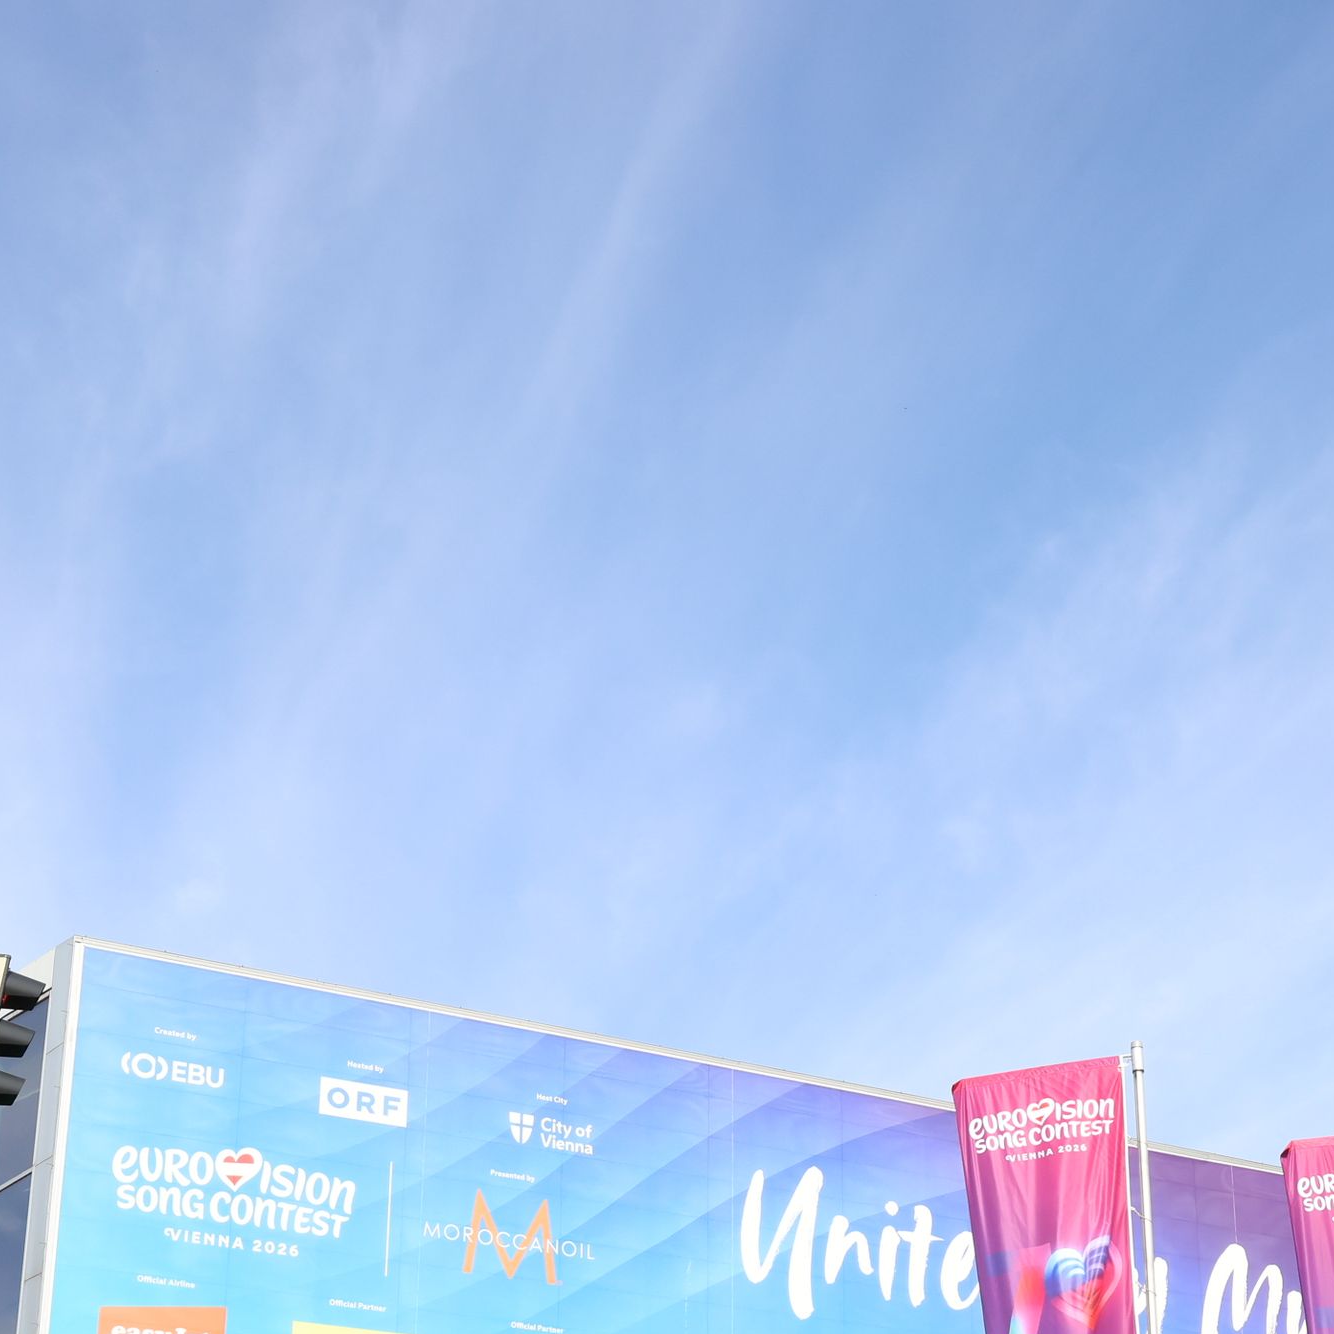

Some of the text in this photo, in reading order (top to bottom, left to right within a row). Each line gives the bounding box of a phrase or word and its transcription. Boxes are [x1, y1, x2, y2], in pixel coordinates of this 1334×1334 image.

[154, 1027, 197, 1041] Created by
[171, 1060, 225, 1088] EBU
[347, 1059, 384, 1074] Hosted by
[327, 1087, 401, 1117] ORF
[536, 1093, 568, 1105] Host City
[540, 1118, 593, 1139] City of
[974, 1120, 1113, 1154] SONG CONTEST
[540, 1133, 594, 1155] Vienna
[1005, 1143, 1087, 1163] VIENNA 2026
[490, 1169, 535, 1183] Presented by
[116, 1184, 349, 1239] SONG CONTEST
[164, 1227, 299, 1257] VIENNA 2026
[423, 1221, 595, 1260] MOROCCANOIL
[740, 1165, 981, 1320] Unite
[137, 1275, 195, 1289] Official Airline
[329, 1298, 386, 1313] Official Partner
[510, 1321, 563, 1334] Official Partner
